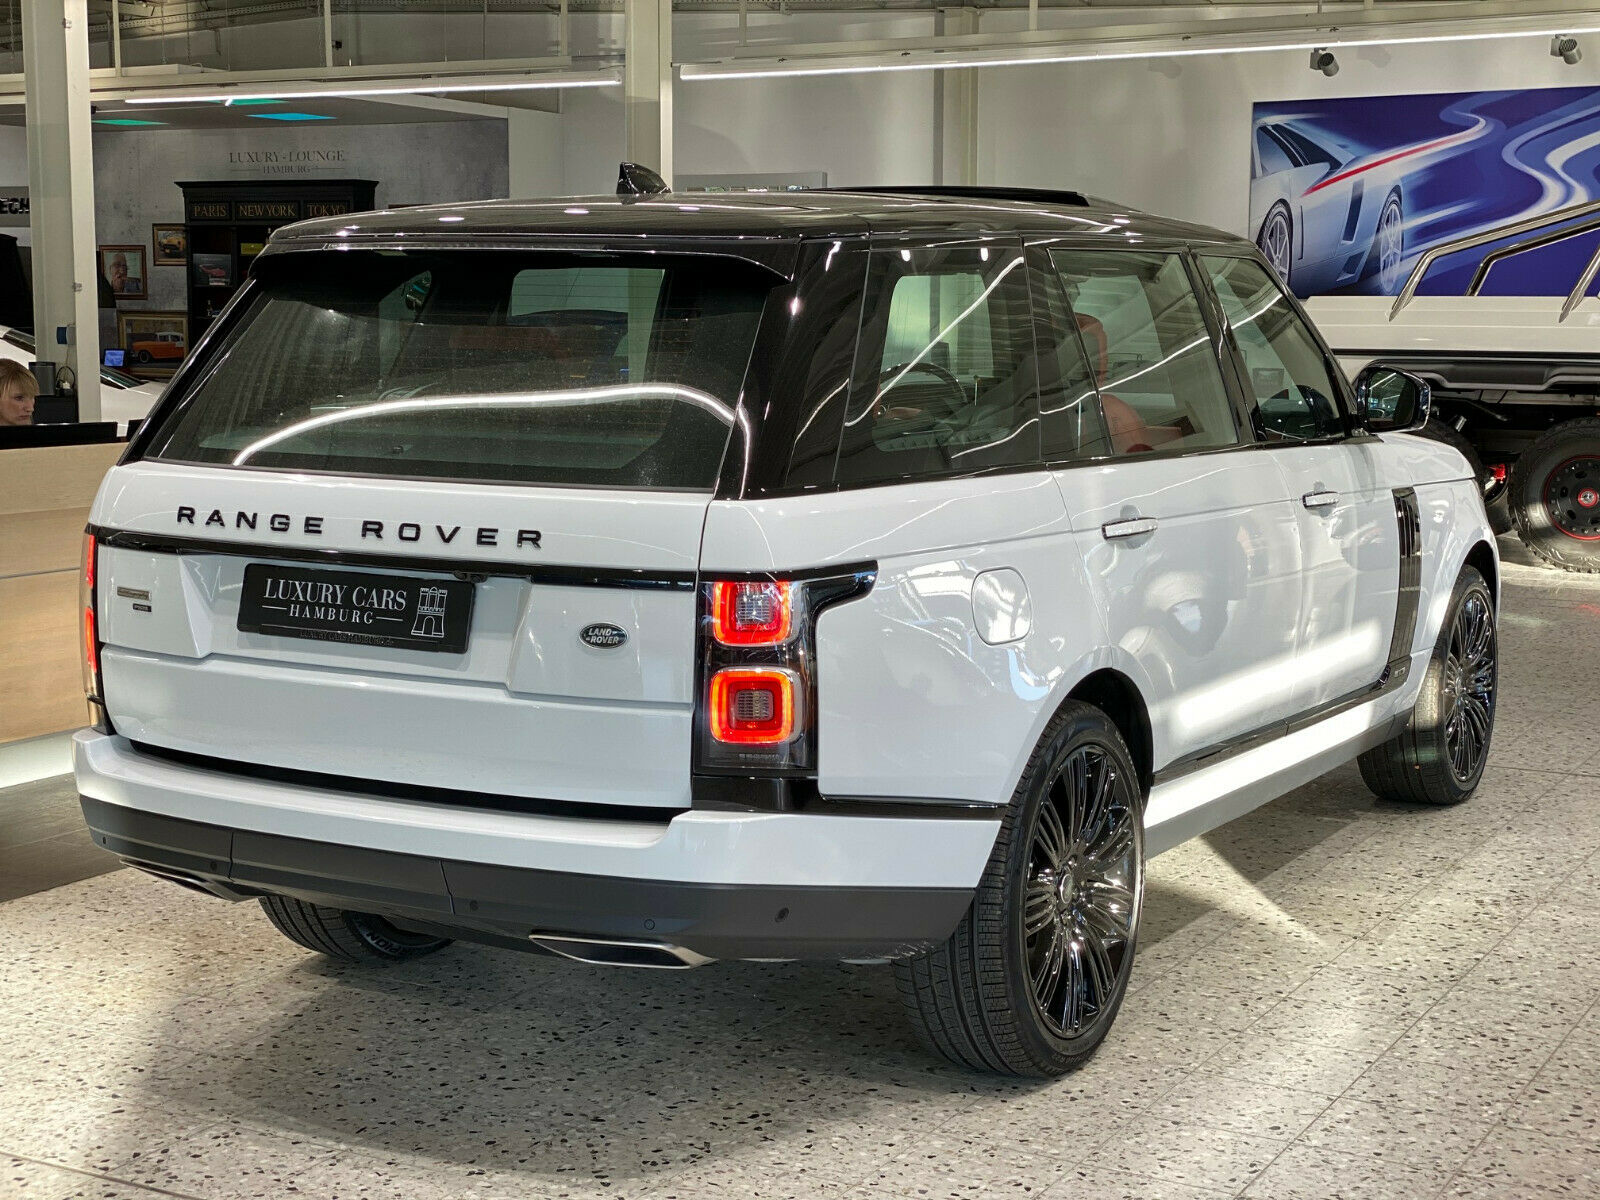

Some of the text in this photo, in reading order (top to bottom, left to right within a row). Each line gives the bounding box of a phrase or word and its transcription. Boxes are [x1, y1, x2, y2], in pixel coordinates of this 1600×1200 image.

[263, 165, 311, 174] HAMBURG
[194, 205, 227, 217] PARIS
[239, 204, 296, 217] NEW YORK
[307, 204, 346, 217] TOKYO
[177, 506, 542, 549] RANGE ROVER
[263, 578, 407, 611] LUXURY CARS
[289, 604, 374, 625] HAMBURG
[588, 628, 612, 636] LAND
[590, 636, 620, 644] ROVER
